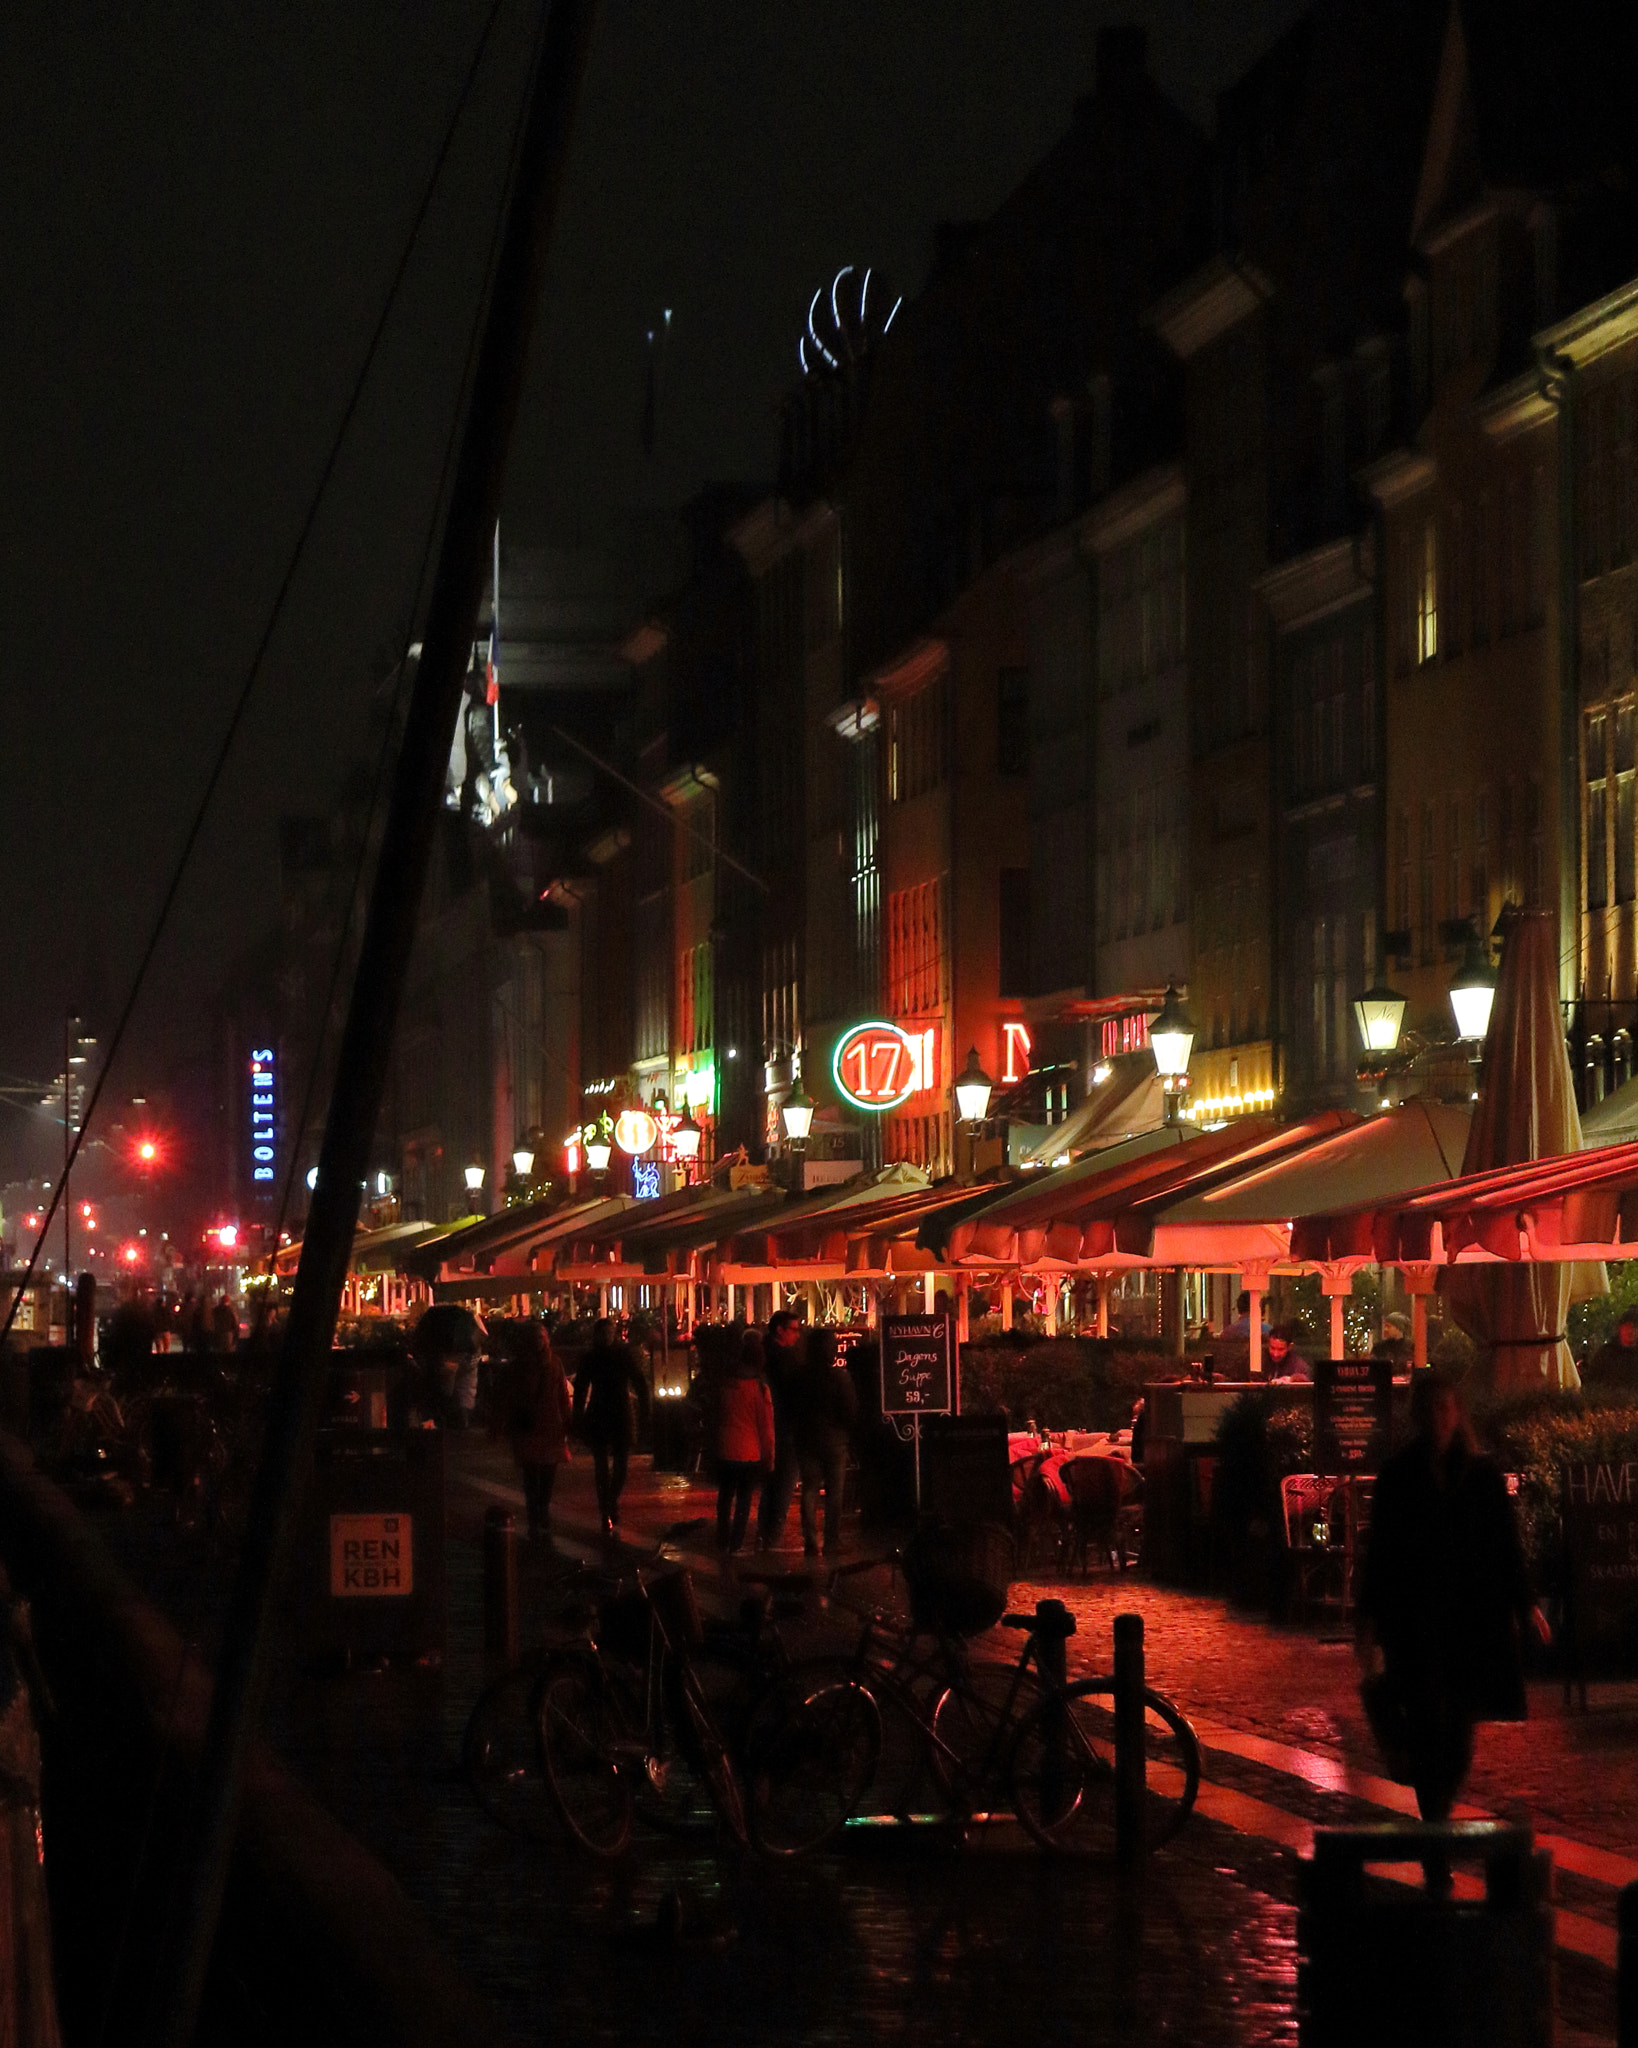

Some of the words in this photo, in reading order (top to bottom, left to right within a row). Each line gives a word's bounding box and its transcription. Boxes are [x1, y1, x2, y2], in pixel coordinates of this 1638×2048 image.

[846, 1042, 902, 1096] 17
[895, 1350, 938, 1368] Dagens
[899, 1368, 932, 1388] Suppe
[343, 1539, 401, 1560] REN
[343, 1567, 401, 1588] KBH
